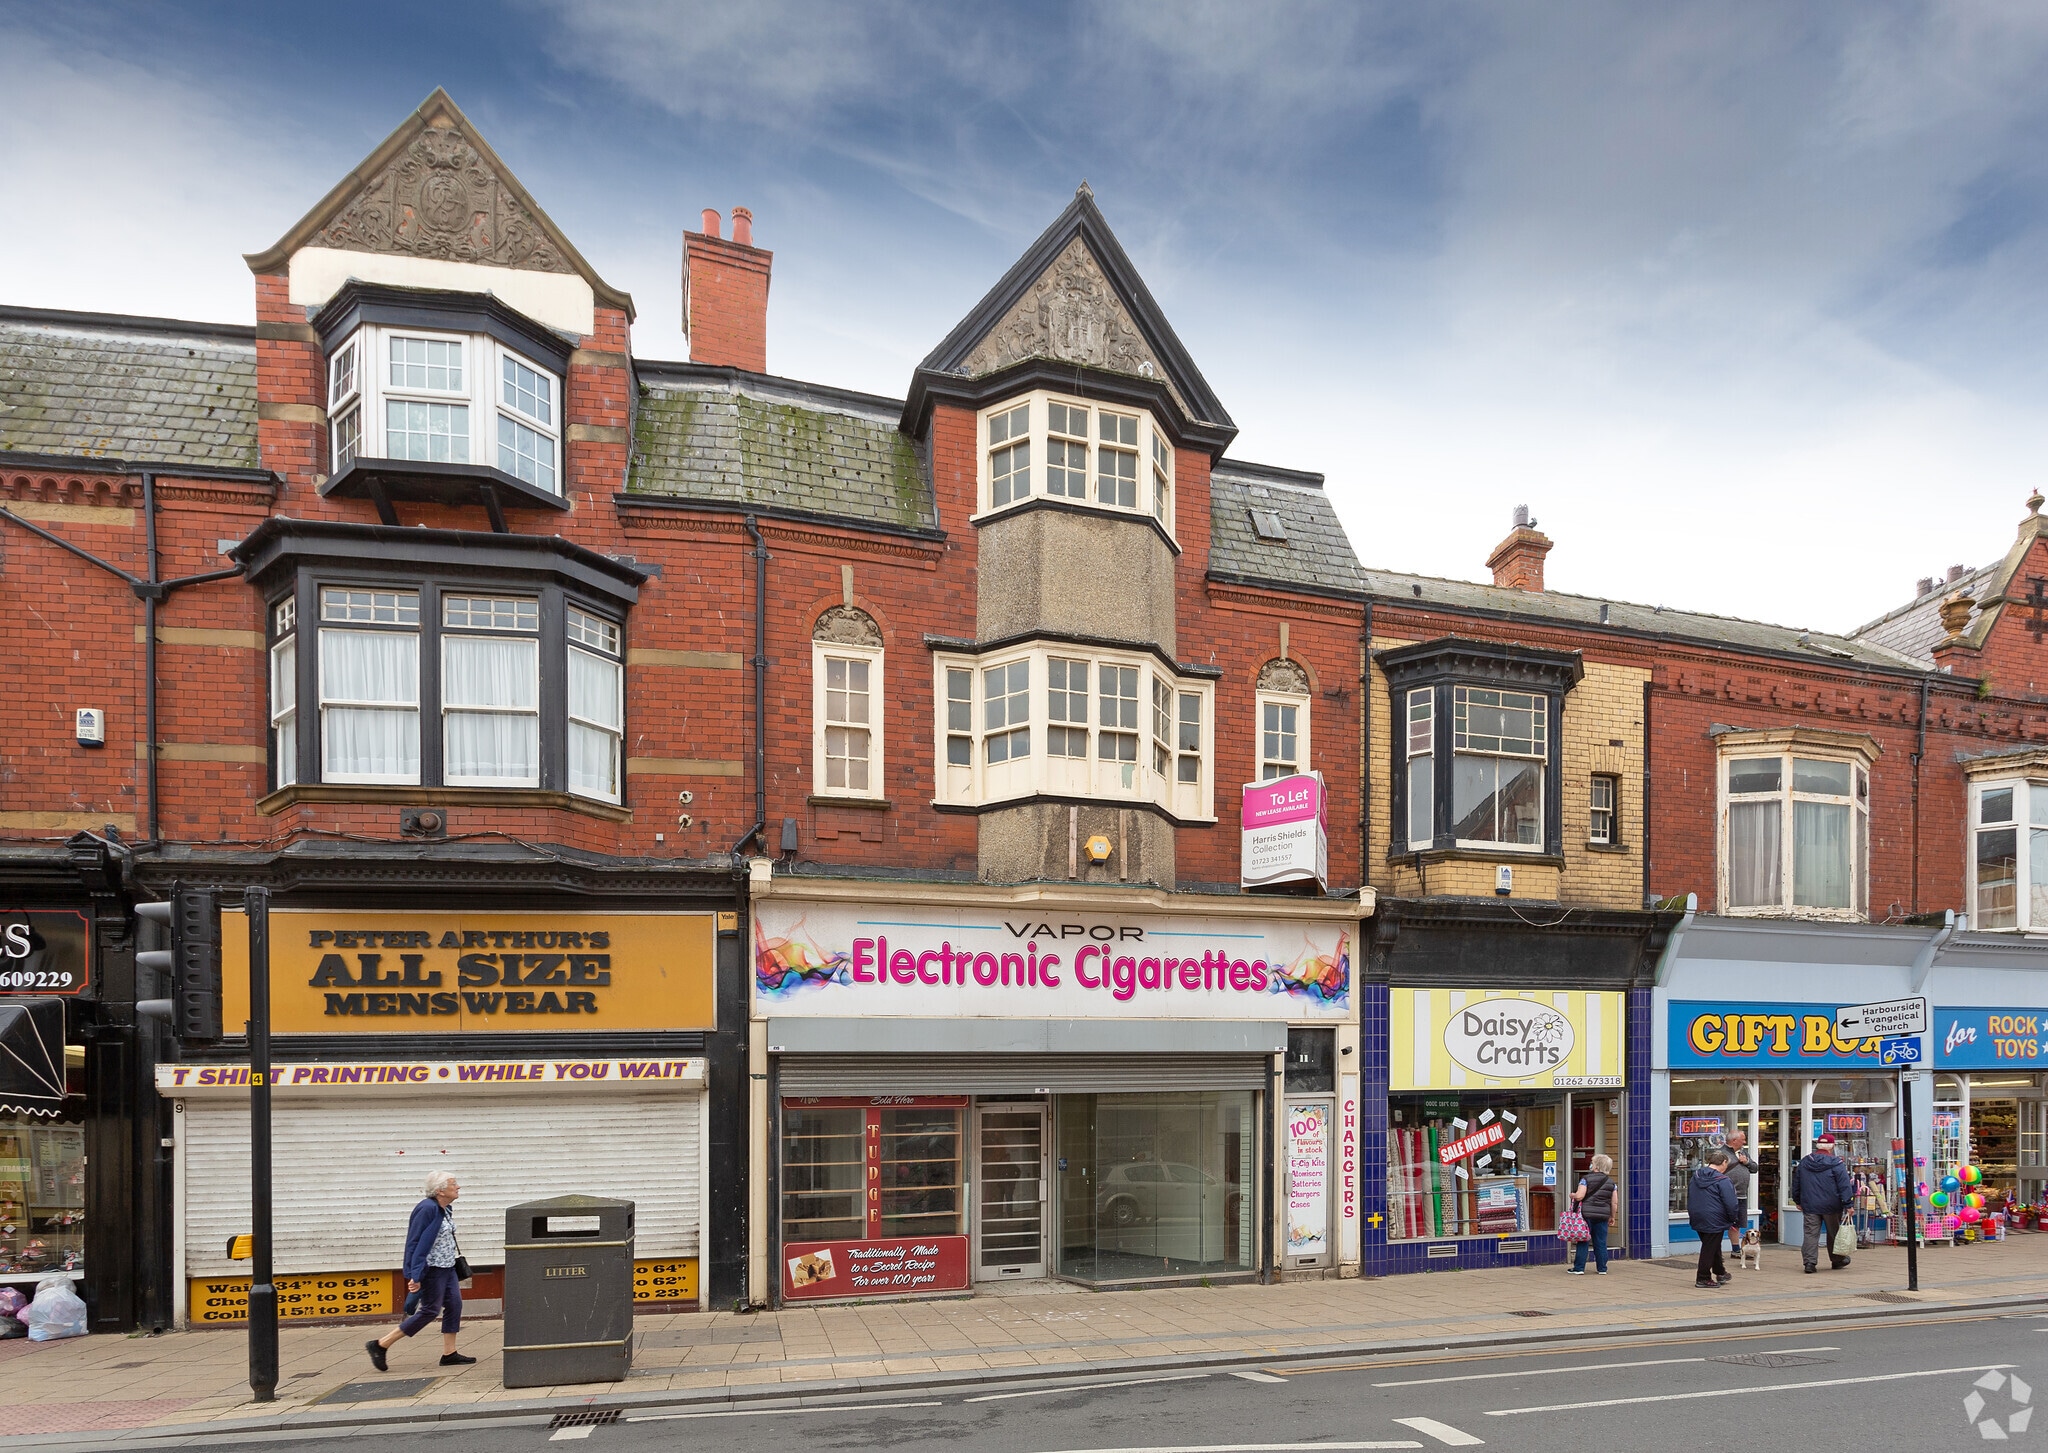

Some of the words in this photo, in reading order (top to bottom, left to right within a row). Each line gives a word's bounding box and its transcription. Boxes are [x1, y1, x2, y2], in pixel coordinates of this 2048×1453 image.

[1270, 793, 1285, 805] To
[1288, 789, 1308, 803] Let
[1283, 803, 1308, 812] AVAILABLE
[1252, 833, 1276, 844] Harris
[1277, 829, 1306, 840] Shields
[1252, 842, 1292, 854] Collection
[1005, 921, 1144, 941] VAPOR
[309, 930, 432, 948] PETER
[438, 930, 610, 949] ARTHUR'S
[309, 954, 441, 986] ALL
[457, 953, 611, 987] SIZE
[853, 935, 1061, 987] Electronic
[1074, 943, 1268, 1001] Cigarettes
[324, 991, 597, 1015] MENSWEAR
[1862, 1002, 1921, 1015] Harbourside
[1864, 1011, 1919, 1024] Evangelical
[1988, 1015, 2038, 1035] ROCK
[1463, 1011, 1533, 1043] Daisy
[1691, 1013, 1796, 1054] GIFT
[1874, 1022, 1909, 1032] Church
[1945, 1020, 1977, 1054] for
[1477, 1039, 1560, 1065] Crafts
[1994, 1039, 2038, 1058] TOYS
[173, 1068, 191, 1087] T
[197, 1067, 286, 1087] SHIT
[291, 1065, 431, 1085] PRINTING
[457, 1062, 547, 1082] WHILE
[553, 1062, 610, 1080] YOU
[617, 1060, 689, 1080] WAIT
[253, 1075, 261, 1084] 4
[1554, 1077, 1583, 1086] 01262
[1587, 1076, 1621, 1085] 673318
[870, 1096, 891, 1105] Sold
[893, 1096, 914, 1104] Here
[175, 1104, 184, 1113] 9
[1290, 1117, 1322, 1138] 100s
[1682, 1120, 1718, 1133] GIFTS
[1830, 1117, 1863, 1129] TOYS
[1440, 1141, 1465, 1162] SALE
[1464, 1131, 1489, 1153] NOW
[1488, 1125, 1503, 1142] ON
[1291, 1160, 1310, 1168] E-Cig
[1343, 1100, 1355, 1218] CHARGERS
[867, 1124, 879, 1222] FUDGE
[1292, 1180, 1321, 1188] Batteries
[1290, 1191, 1320, 1199] Chargers
[847, 1246, 906, 1260] Traditionally
[911, 1245, 939, 1256] Made
[546, 1266, 586, 1277] LITTER
[851, 1263, 860, 1273] to
[870, 1261, 902, 1273] Secret
[905, 1259, 935, 1271] Recipe
[851, 1276, 869, 1287] For
[871, 1277, 889, 1286] over
[891, 1273, 910, 1284] 100
[912, 1274, 936, 1288] years
